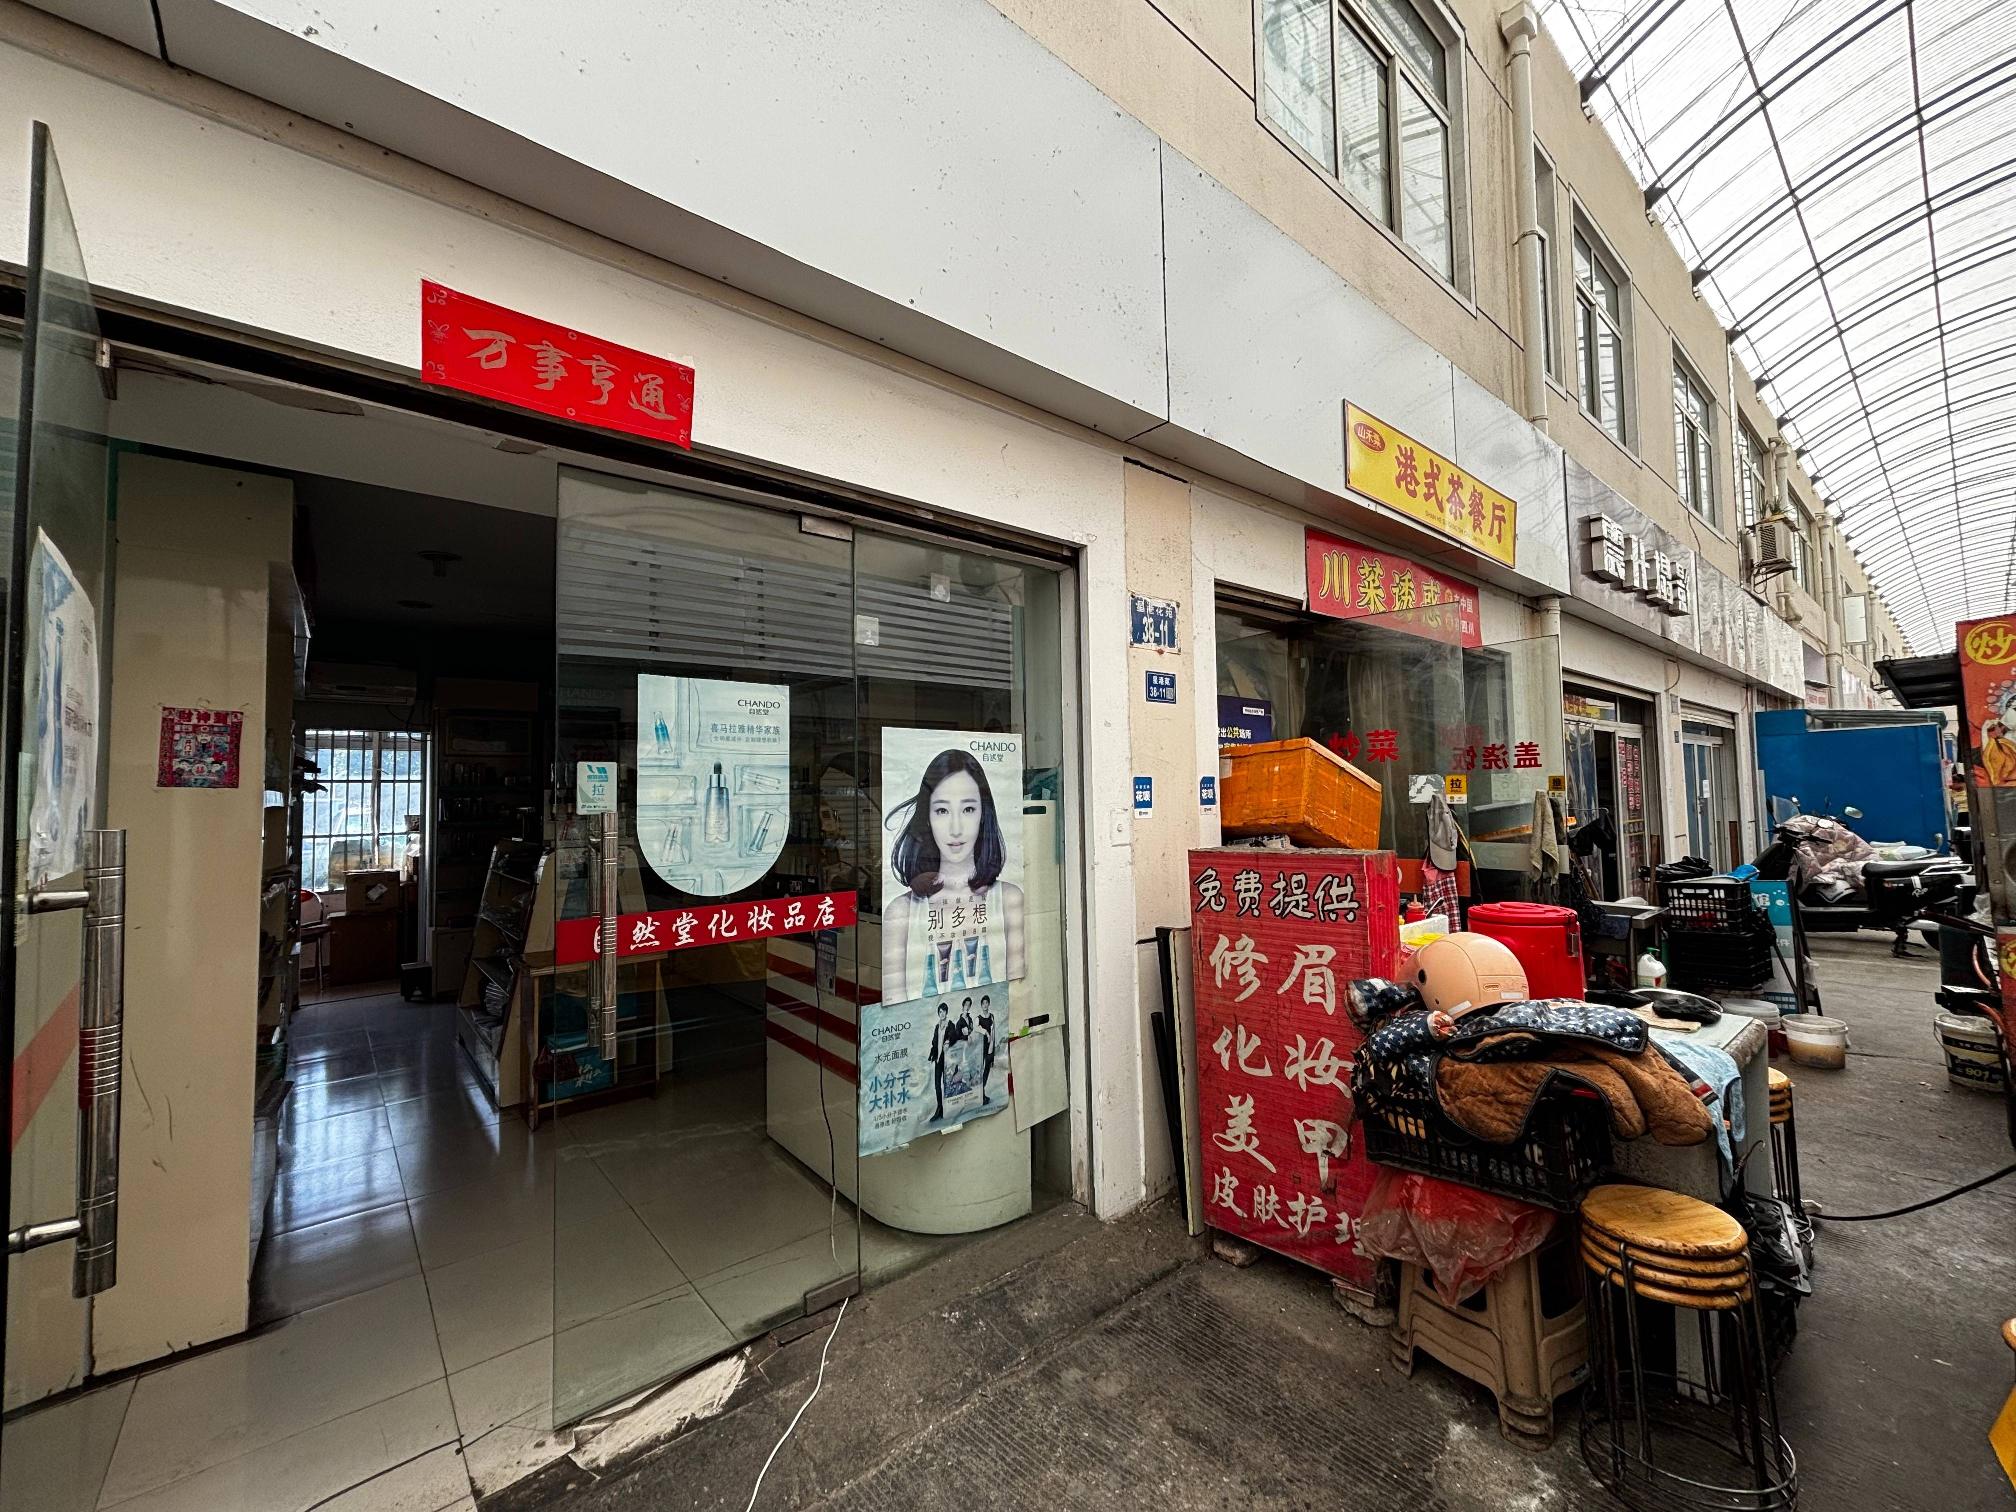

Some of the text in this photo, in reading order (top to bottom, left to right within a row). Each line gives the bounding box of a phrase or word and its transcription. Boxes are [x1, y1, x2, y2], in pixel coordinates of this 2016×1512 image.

[461, 326, 677, 421] 万事亨通
[1395, 444, 1506, 544] 港式茶餐厅
[1319, 550, 1441, 629] 川菜诱惑
[1143, 616, 1168, 646] 38-11
[737, 699, 781, 709] CHANDO
[969, 740, 1016, 753] CHANDO
[592, 783, 605, 796] 拉
[1450, 778, 1462, 788] 拉
[1195, 868, 1361, 922] 免费提供
[927, 903, 988, 931] 别多想
[1208, 933, 1337, 1016] 修眉
[871, 1021, 911, 1037] CHANDO
[874, 1047, 908, 1064] 水光面膜
[1212, 1024, 1355, 1098] 化妆
[869, 1068, 911, 1094] 小分子
[868, 1086, 911, 1113] 大补水
[1213, 1093, 1350, 1191] 美甲
[1210, 1166, 1375, 1261] 皮肤护理
